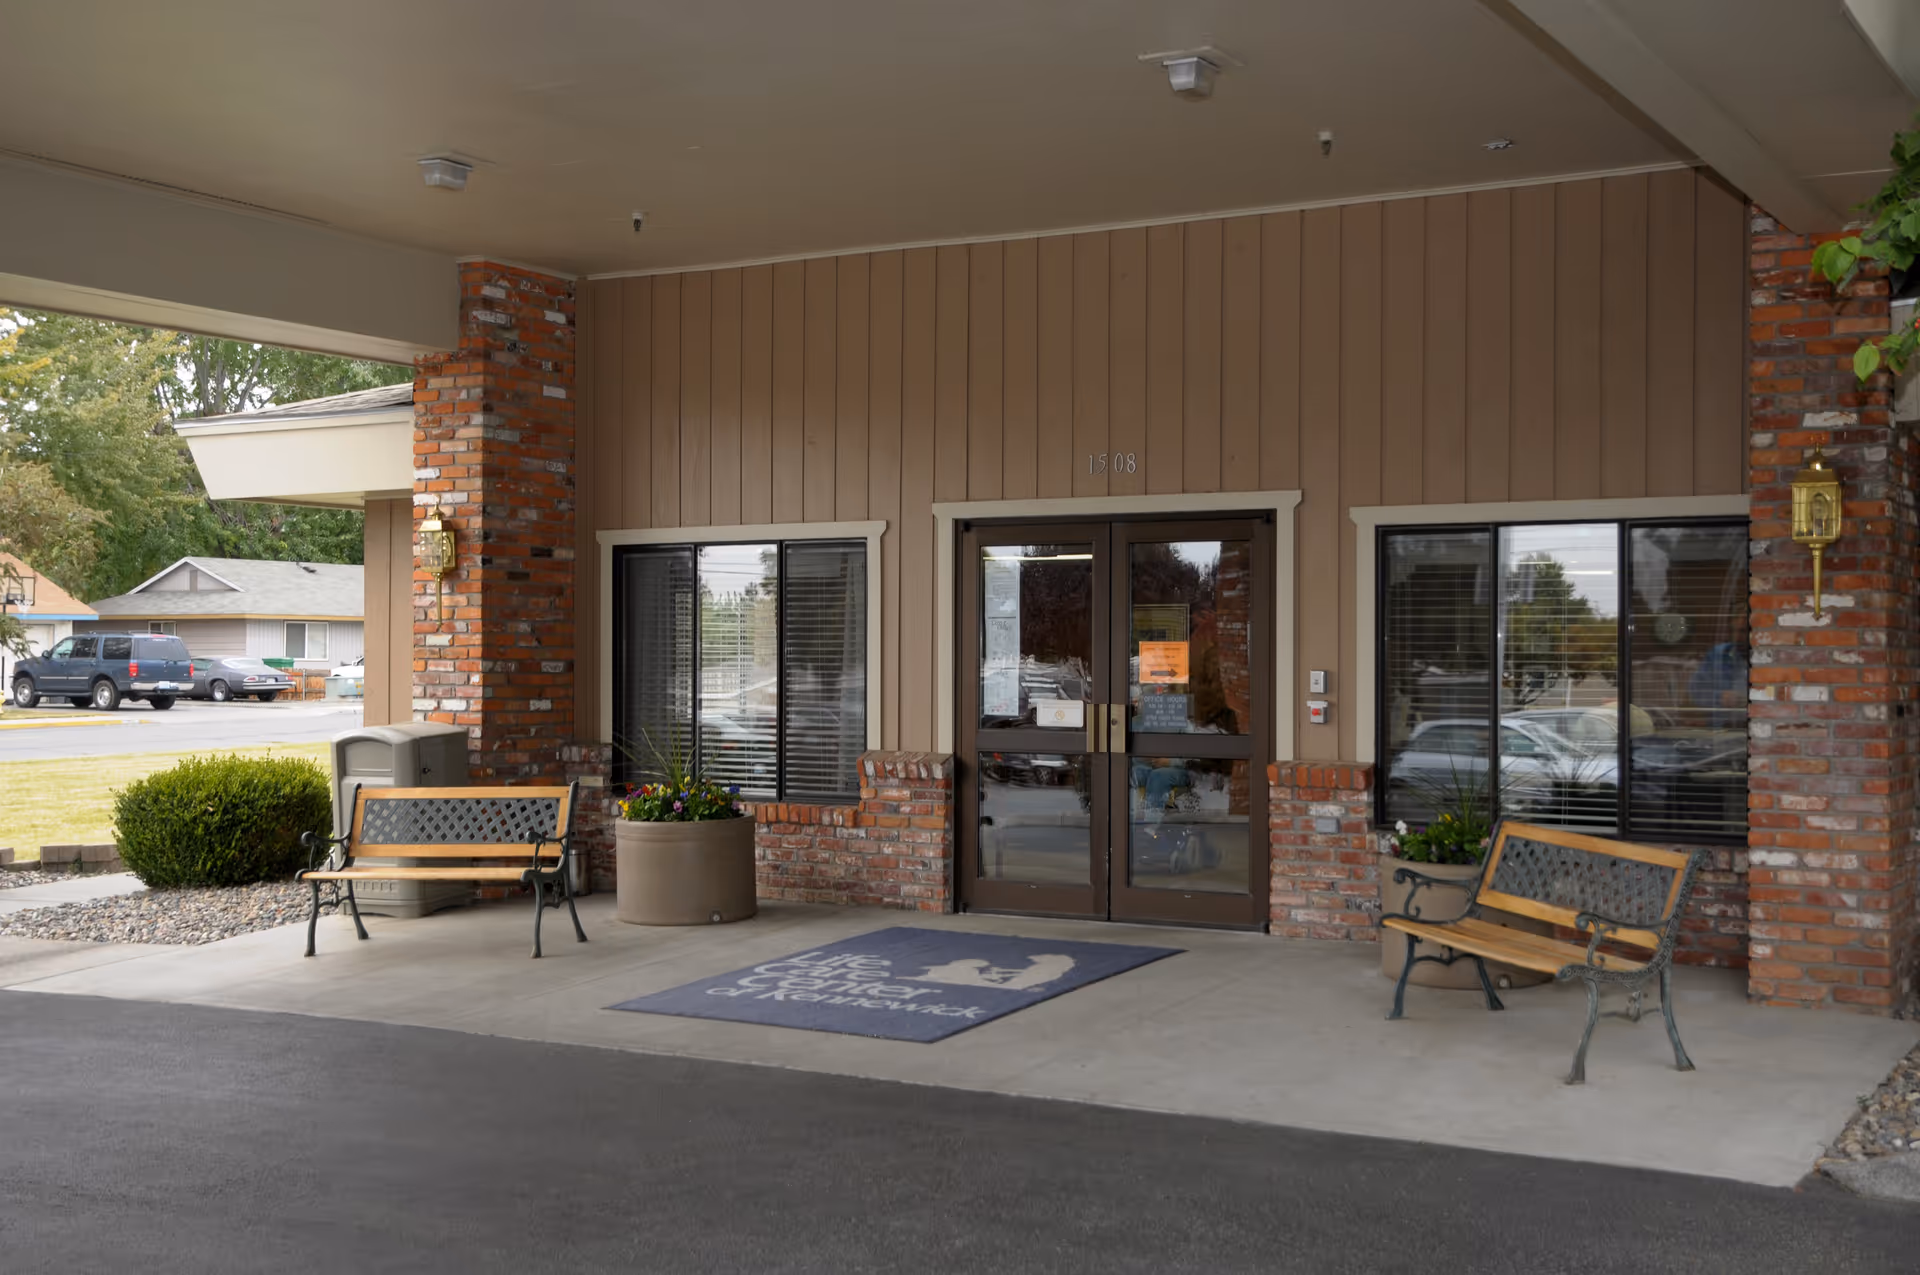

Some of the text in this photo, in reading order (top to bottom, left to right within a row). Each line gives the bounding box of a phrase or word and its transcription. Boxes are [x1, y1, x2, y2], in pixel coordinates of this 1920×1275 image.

[1088, 452, 1136, 475] 1508
[753, 962, 891, 980] Care
[784, 951, 892, 970] Life
[737, 974, 943, 1000] Center
[705, 986, 986, 1019] of Kennewick
